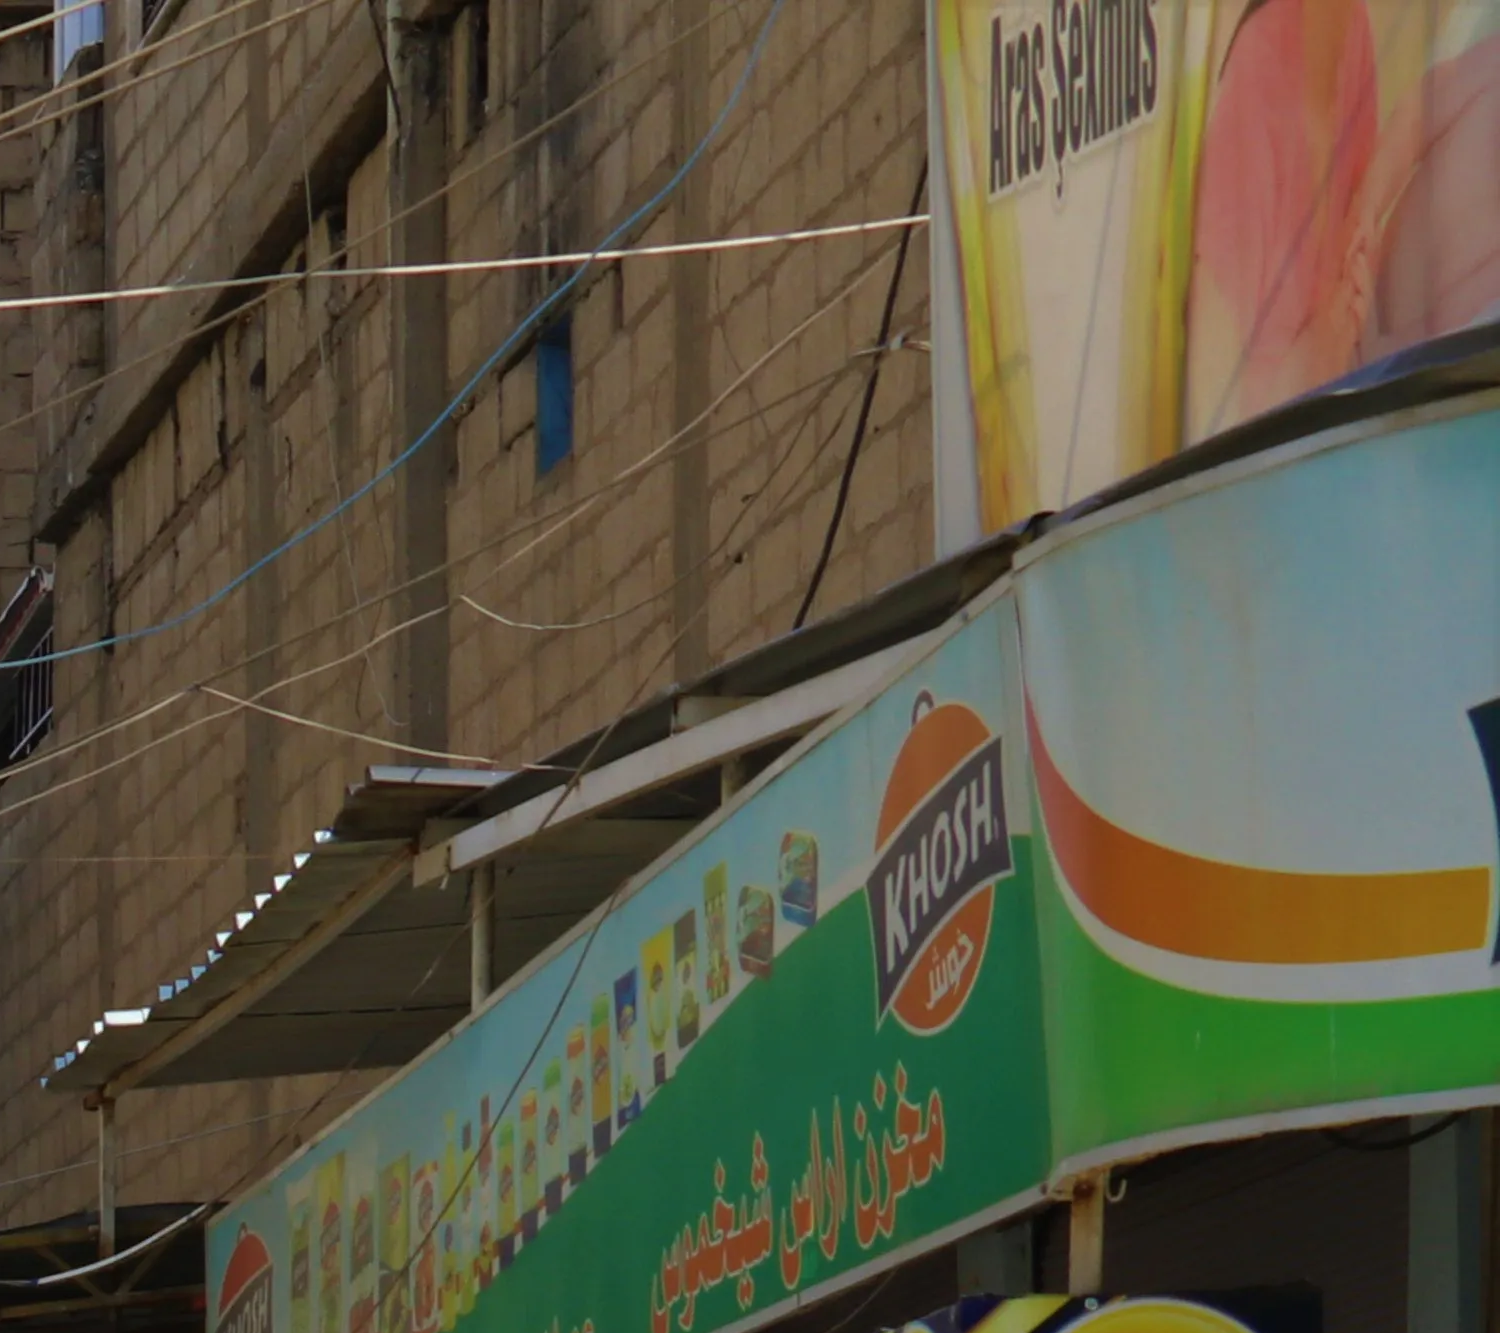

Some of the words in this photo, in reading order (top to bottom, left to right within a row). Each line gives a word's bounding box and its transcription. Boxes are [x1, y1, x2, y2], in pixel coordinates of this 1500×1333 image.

[989, 16, 1046, 195] Aras
[885, 760, 993, 975] KHOSH
[779, 1095, 848, 1290] اراس
[854, 1059, 946, 1250] مخزن
